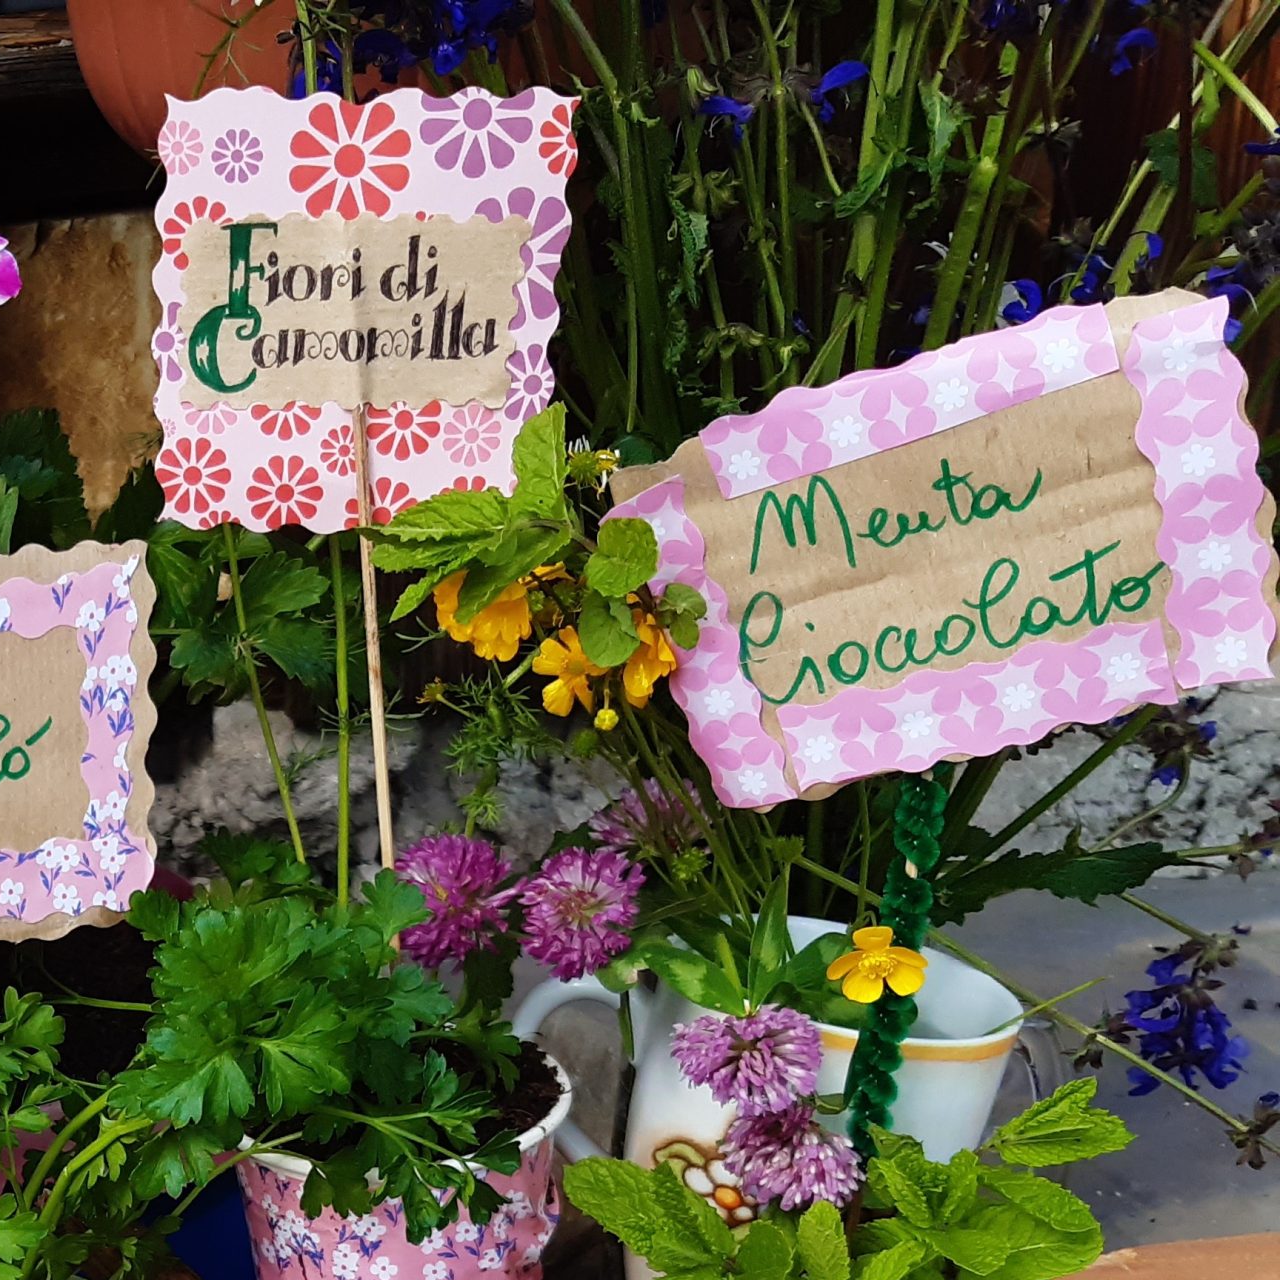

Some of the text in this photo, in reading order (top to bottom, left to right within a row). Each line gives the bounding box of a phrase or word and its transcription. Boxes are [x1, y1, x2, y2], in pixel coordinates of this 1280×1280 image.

[220, 221, 441, 320] Fiori di
[188, 288, 500, 394] Camomilla
[748, 457, 1043, 575] Menta
